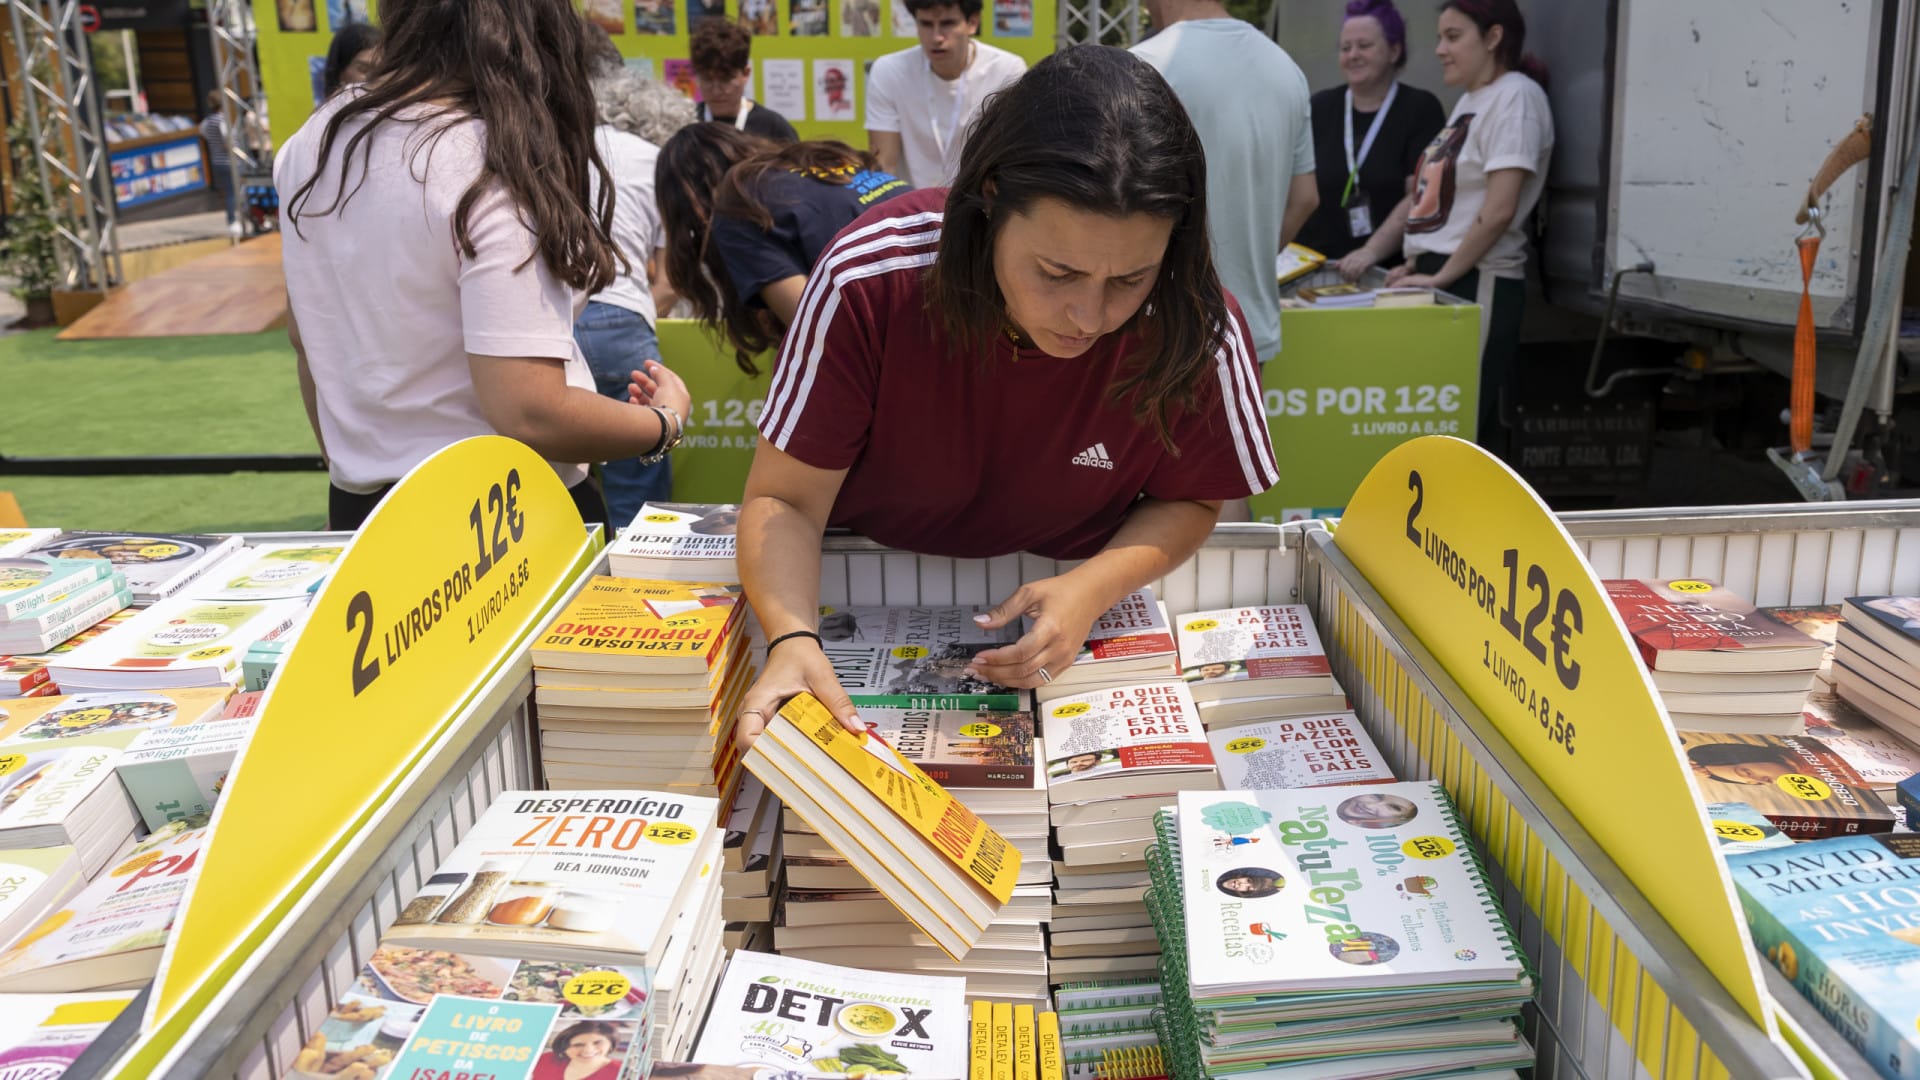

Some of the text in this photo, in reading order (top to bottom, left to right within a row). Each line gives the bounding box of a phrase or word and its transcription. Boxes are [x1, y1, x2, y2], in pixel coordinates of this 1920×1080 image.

[1316, 384, 1461, 415] POR 12€
[1351, 420, 1459, 435] 1 LIVRO A 8,5€
[721, 436, 732, 448] A
[735, 436, 759, 449] 8,5
[1072, 455, 1113, 470] adidas
[629, 534, 736, 546] RBULÊNCIA
[346, 468, 524, 698] 2 LIVROS POR 12€
[1406, 470, 1583, 691] 2 LIVROS POR 12€
[1675, 583, 1708, 591] 12€
[592, 585, 628, 593] JUDIS
[645, 588, 675, 596] JOHN
[15, 600, 29, 613] 200
[27, 591, 45, 610] light
[467, 557, 529, 644] 1 LIVRO A 8,5€
[56, 606, 73, 623] light
[1240, 607, 1298, 618] O QUE
[1636, 604, 1717, 614] NEM
[665, 618, 701, 627] 12€
[1100, 619, 1153, 630] PAÍS
[1238, 614, 1301, 625] FAZER
[1637, 612, 1746, 623] TUDO
[554, 623, 712, 640] POPULISMO
[1189, 621, 1215, 631] 12€
[1264, 623, 1303, 632] COM
[1667, 620, 1753, 631] SERÁ
[49, 624, 75, 643] 200 light
[1252, 631, 1306, 641] ESTE
[1672, 629, 1775, 639] ESQUECIDO
[544, 635, 704, 651] A EXPLOSÃO DO
[1255, 638, 1309, 650] PAÍS
[1112, 691, 1124, 699] O
[1134, 686, 1175, 698] QUE
[1483, 640, 1576, 756] 1 LIVRO A 8,5€
[1055, 704, 1088, 716] 12€
[1110, 696, 1179, 710] FAZER
[1139, 705, 1182, 715] COM
[1127, 714, 1186, 727] ESTE
[1280, 718, 1346, 732] O QUE
[170, 721, 208, 736] light
[897, 711, 930, 760] MERCADOS
[975, 724, 990, 736] 12€
[1129, 722, 1189, 737] PAÍS
[1281, 728, 1353, 743] FAZER
[163, 733, 198, 746] light
[1229, 740, 1263, 751] 12€
[1313, 738, 1358, 750] COM
[153, 745, 189, 760] light
[1304, 748, 1366, 763] ESTE
[1309, 758, 1372, 774] PAÍS
[987, 772, 1025, 780] MARCADOR
[1791, 777, 1821, 798] 12€
[1816, 766, 1859, 806] DEBORAH
[513, 796, 684, 819] DESPERDÍCIO
[511, 815, 649, 851] ZERO
[648, 829, 692, 841] 12€
[1714, 825, 1760, 837] 12€
[1365, 834, 1407, 877] 100%
[1412, 837, 1442, 859] 12€
[590, 852, 628, 861] desperdício
[1746, 848, 1883, 879] DAVID
[553, 861, 650, 879] BEA JOHNSON
[1800, 885, 1920, 922] AS HO
[1220, 901, 1246, 958] Receitas
[1429, 901, 1455, 944] Plantamos
[1400, 914, 1424, 952] colhemos
[570, 984, 624, 996] 12€
[796, 981, 838, 995] meu
[840, 989, 932, 1007] programa
[488, 1005, 500, 1015] O
[1819, 973, 1870, 1033] HORAS
[450, 1012, 523, 1033] LIVRO
[750, 1019, 785, 1036] 40
[469, 1031, 490, 1042] DE
[411, 1037, 532, 1062] PETISCOS
[453, 1058, 474, 1070] DA
